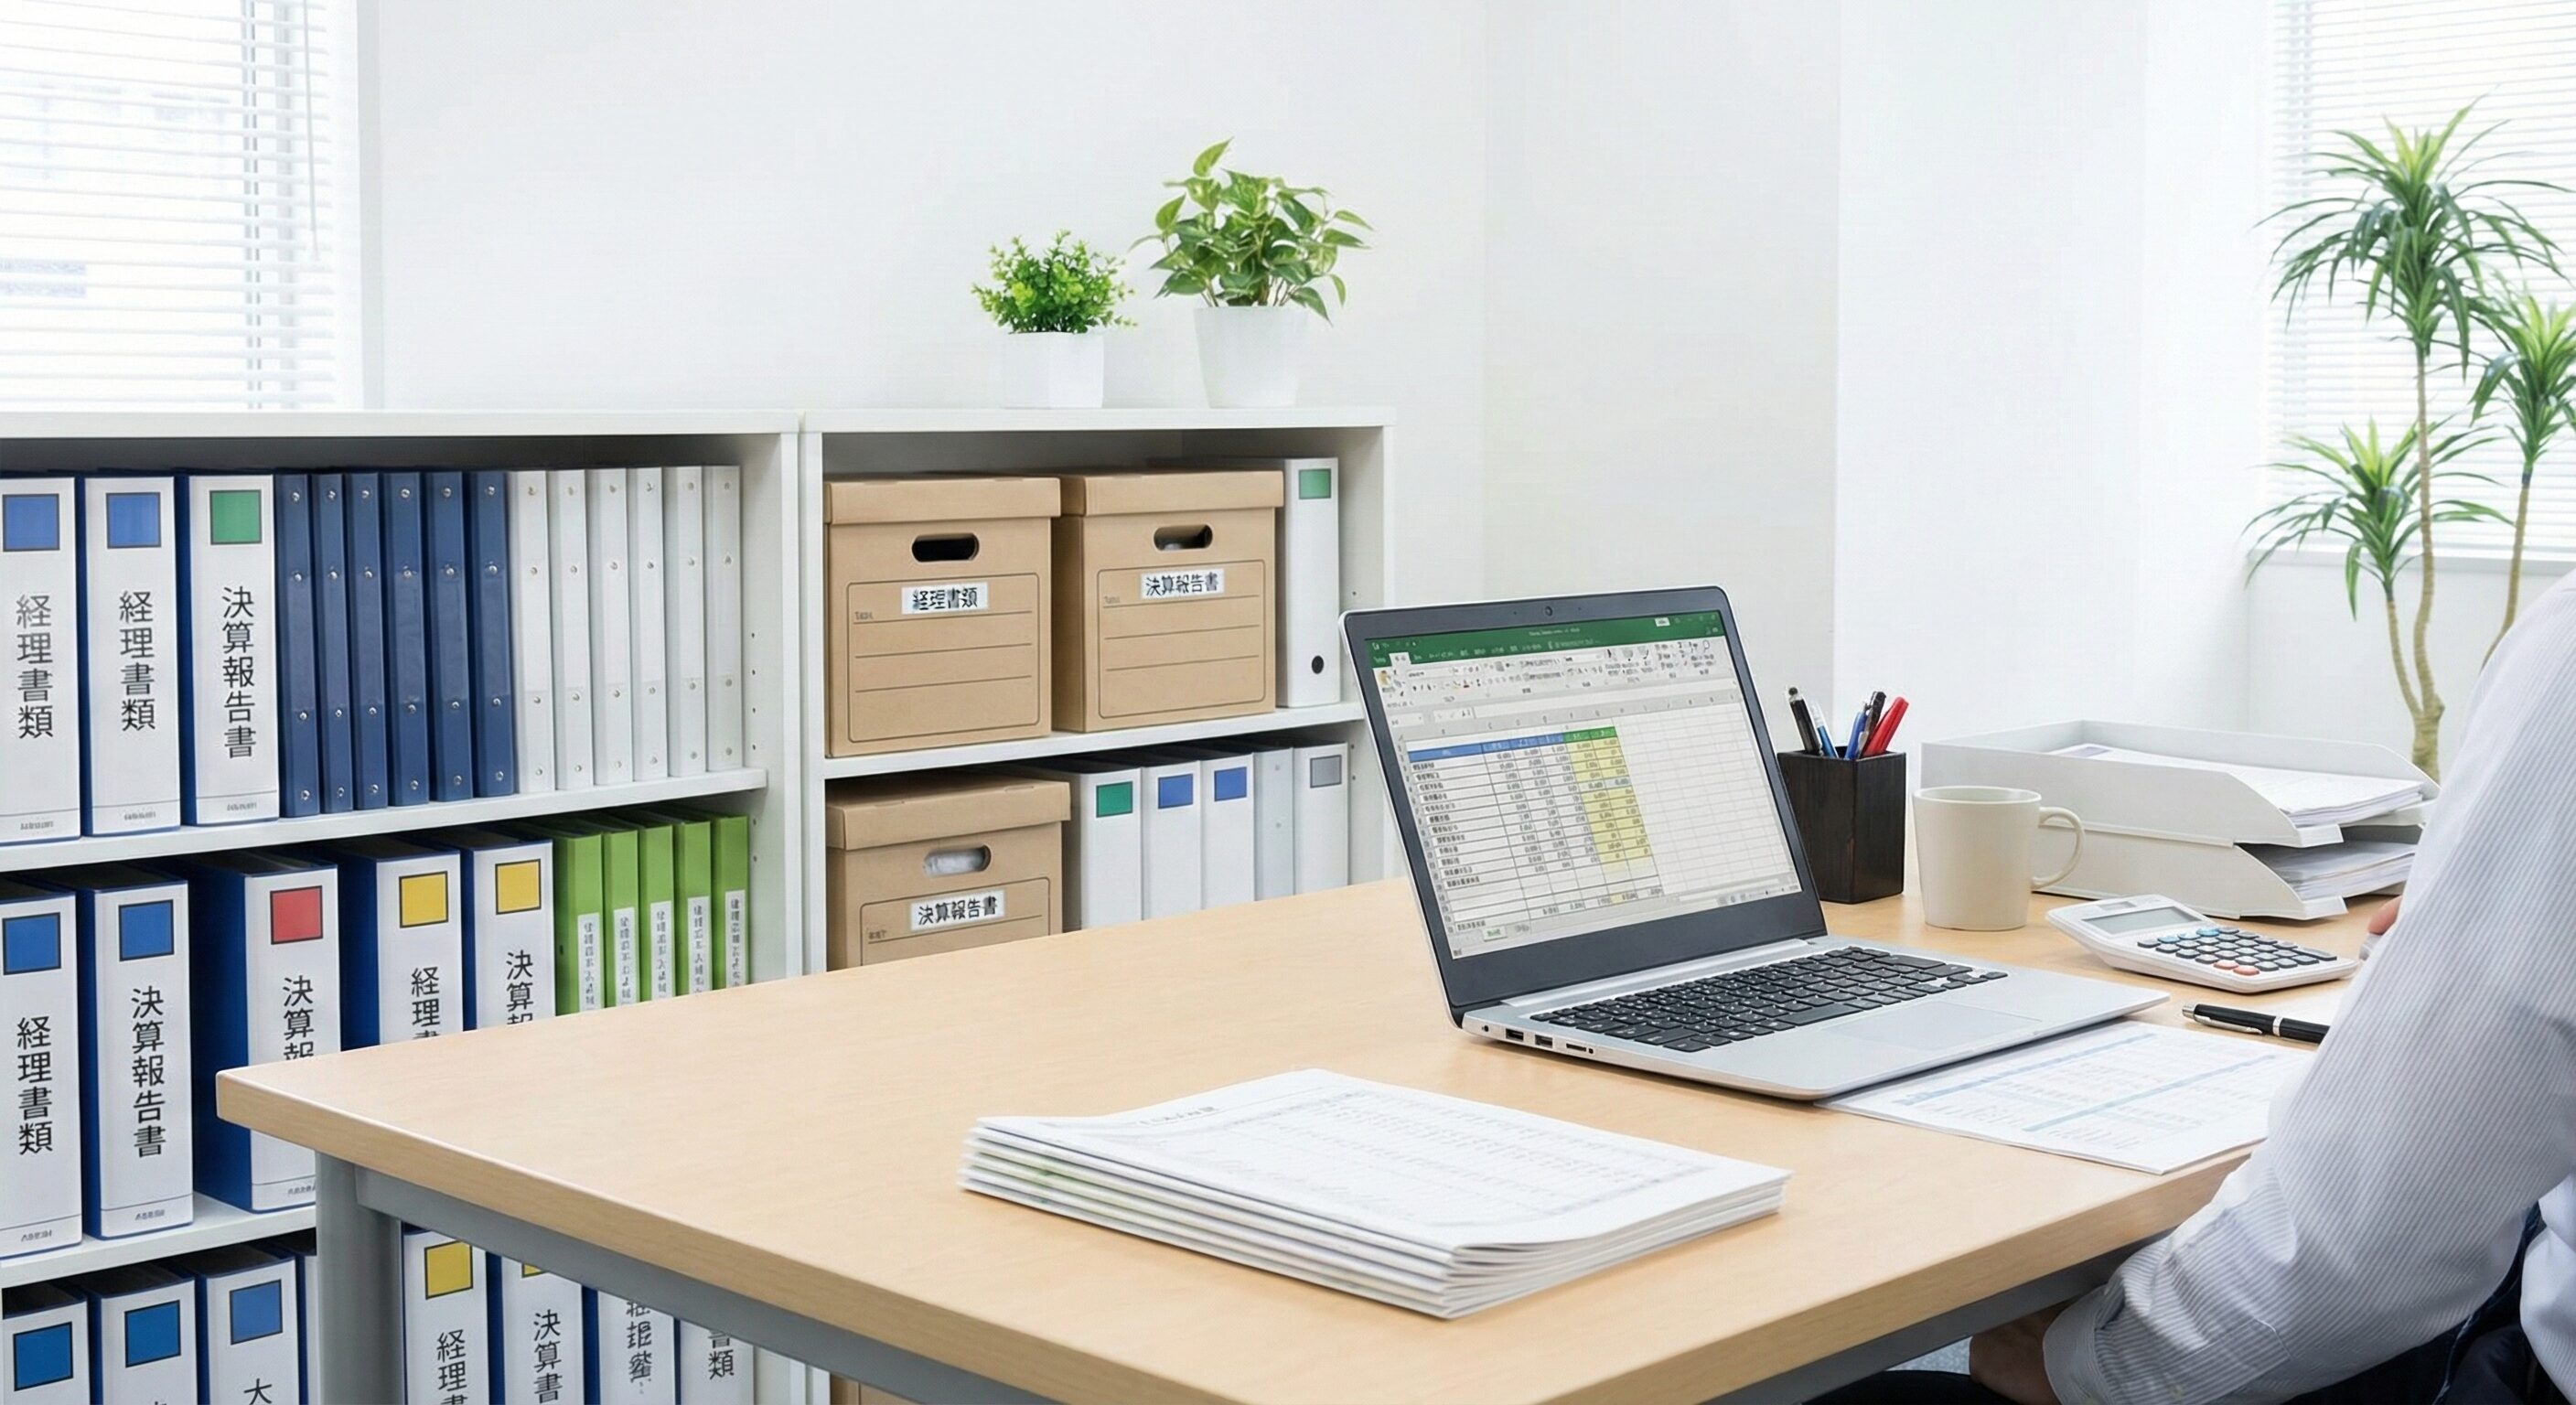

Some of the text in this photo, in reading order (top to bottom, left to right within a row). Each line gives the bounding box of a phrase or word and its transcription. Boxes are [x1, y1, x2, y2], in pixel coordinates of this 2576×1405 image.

[16, 595, 53, 739] 経理書類
[119, 591, 156, 731] 経理書類
[222, 586, 256, 758] 決算報告書
[132, 985, 166, 1158] 決算報告書
[412, 967, 440, 1039] 経理
[17, 1015, 52, 1155] 経理書類
[243, 1378, 273, 1405] 大
[533, 1309, 563, 1404] 決算書
